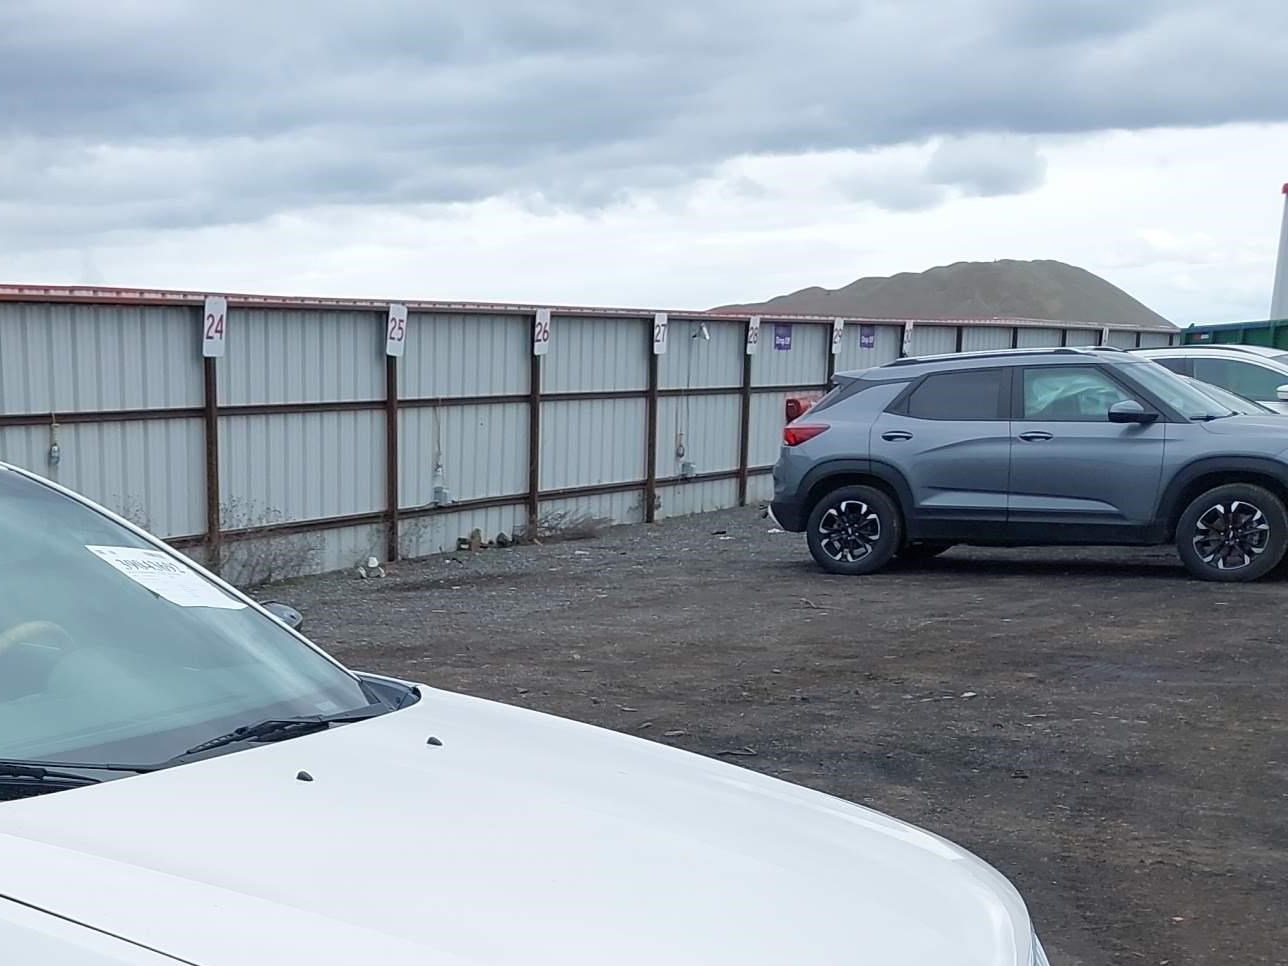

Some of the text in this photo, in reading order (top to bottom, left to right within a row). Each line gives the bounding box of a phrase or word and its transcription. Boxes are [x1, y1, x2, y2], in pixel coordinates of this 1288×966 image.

[205, 313, 224, 340] 24
[388, 317, 405, 342] 25
[535, 322, 550, 343] 26
[654, 324, 667, 343] 27
